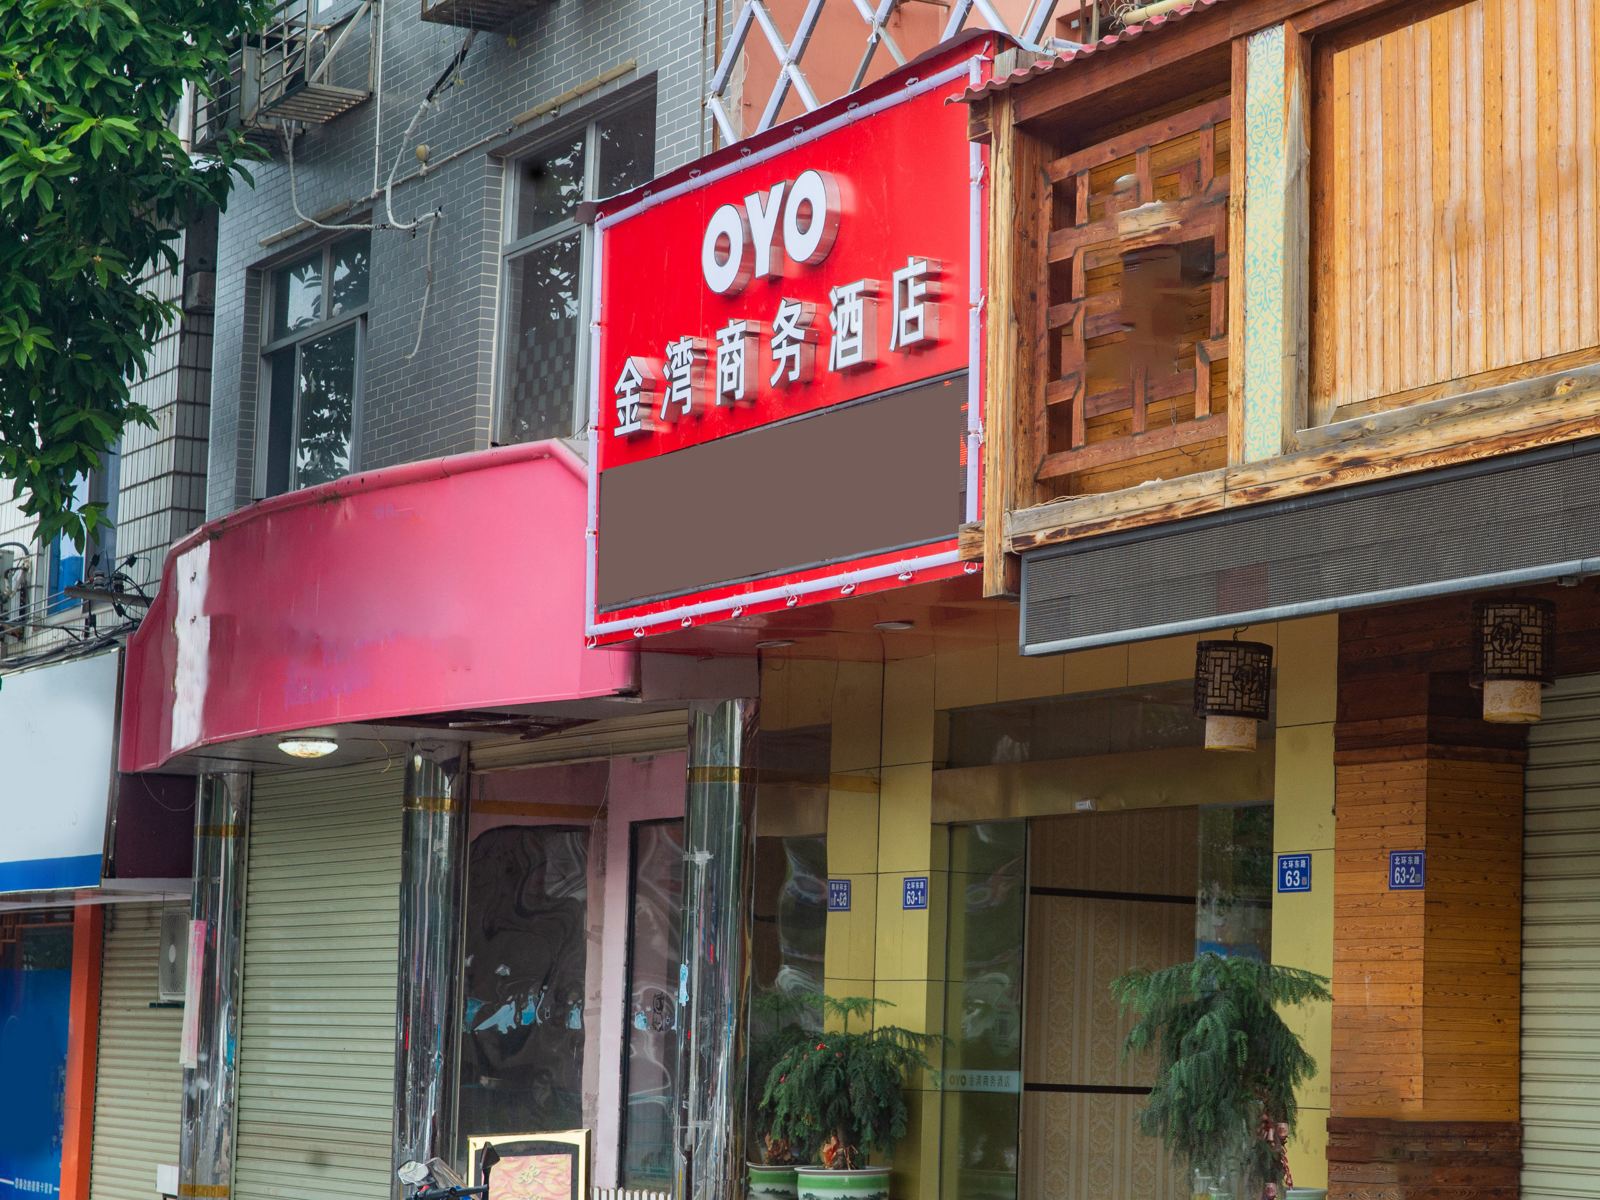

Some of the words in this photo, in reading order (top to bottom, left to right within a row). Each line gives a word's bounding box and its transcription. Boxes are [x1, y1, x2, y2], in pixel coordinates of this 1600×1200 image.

[702, 169, 841, 295] OYO
[613, 256, 942, 438] 金湾商务酒店
[1282, 859, 1306, 868] 北环东路
[1285, 870, 1300, 887] 63
[1394, 867, 1415, 883] 63-2
[906, 891, 921, 904] 63-1
